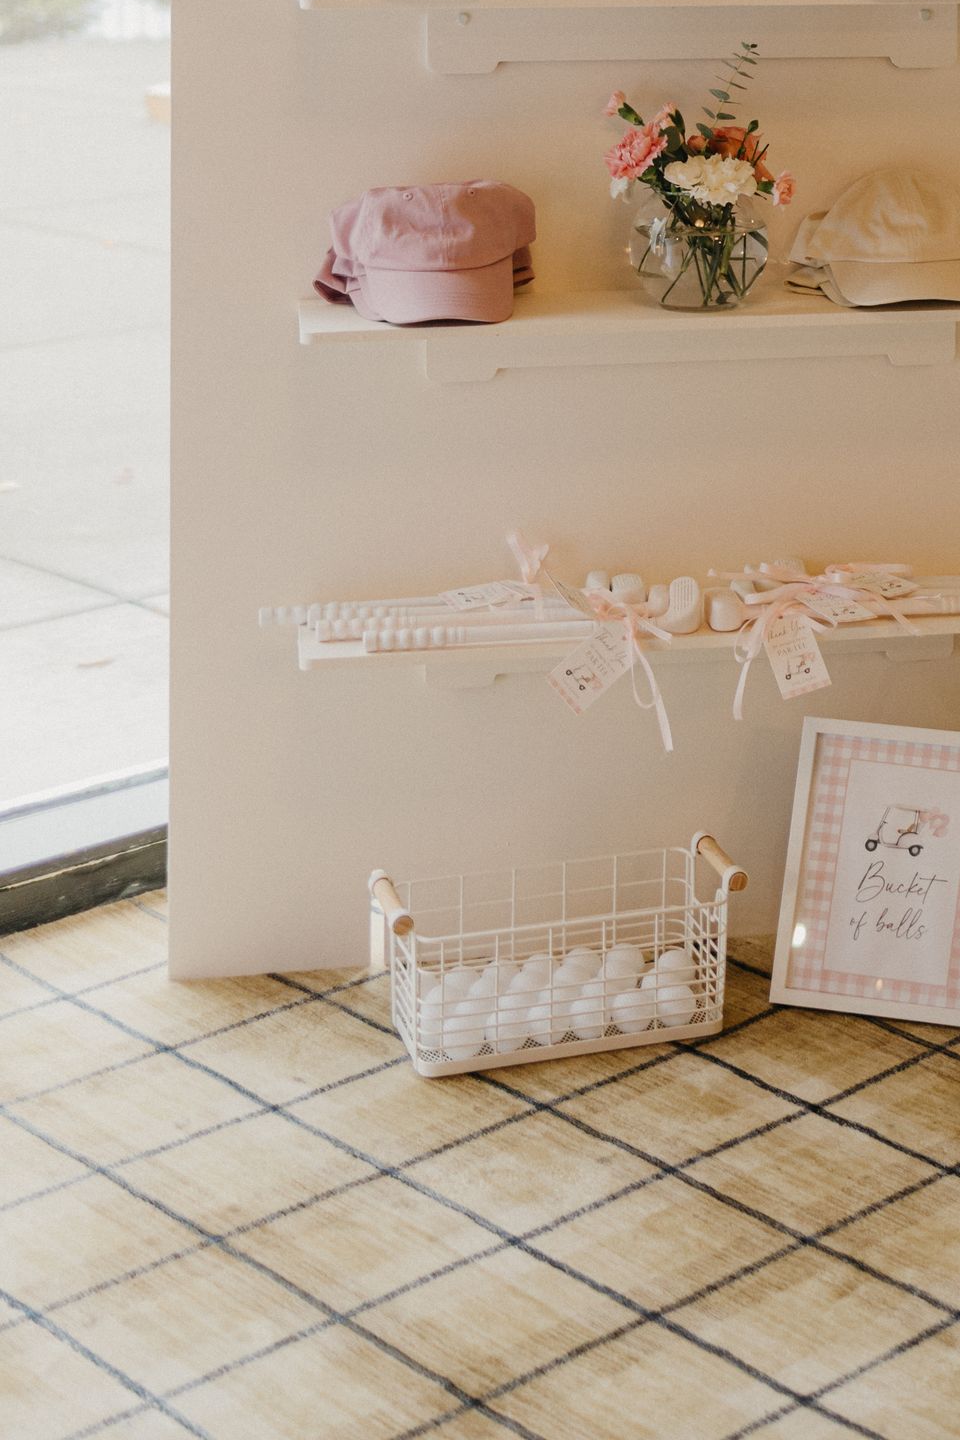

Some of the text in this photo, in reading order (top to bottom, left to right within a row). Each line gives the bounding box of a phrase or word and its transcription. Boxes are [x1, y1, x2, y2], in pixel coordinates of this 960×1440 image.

[855, 860, 948, 904] Bucket
[850, 907, 927, 941] of balls
